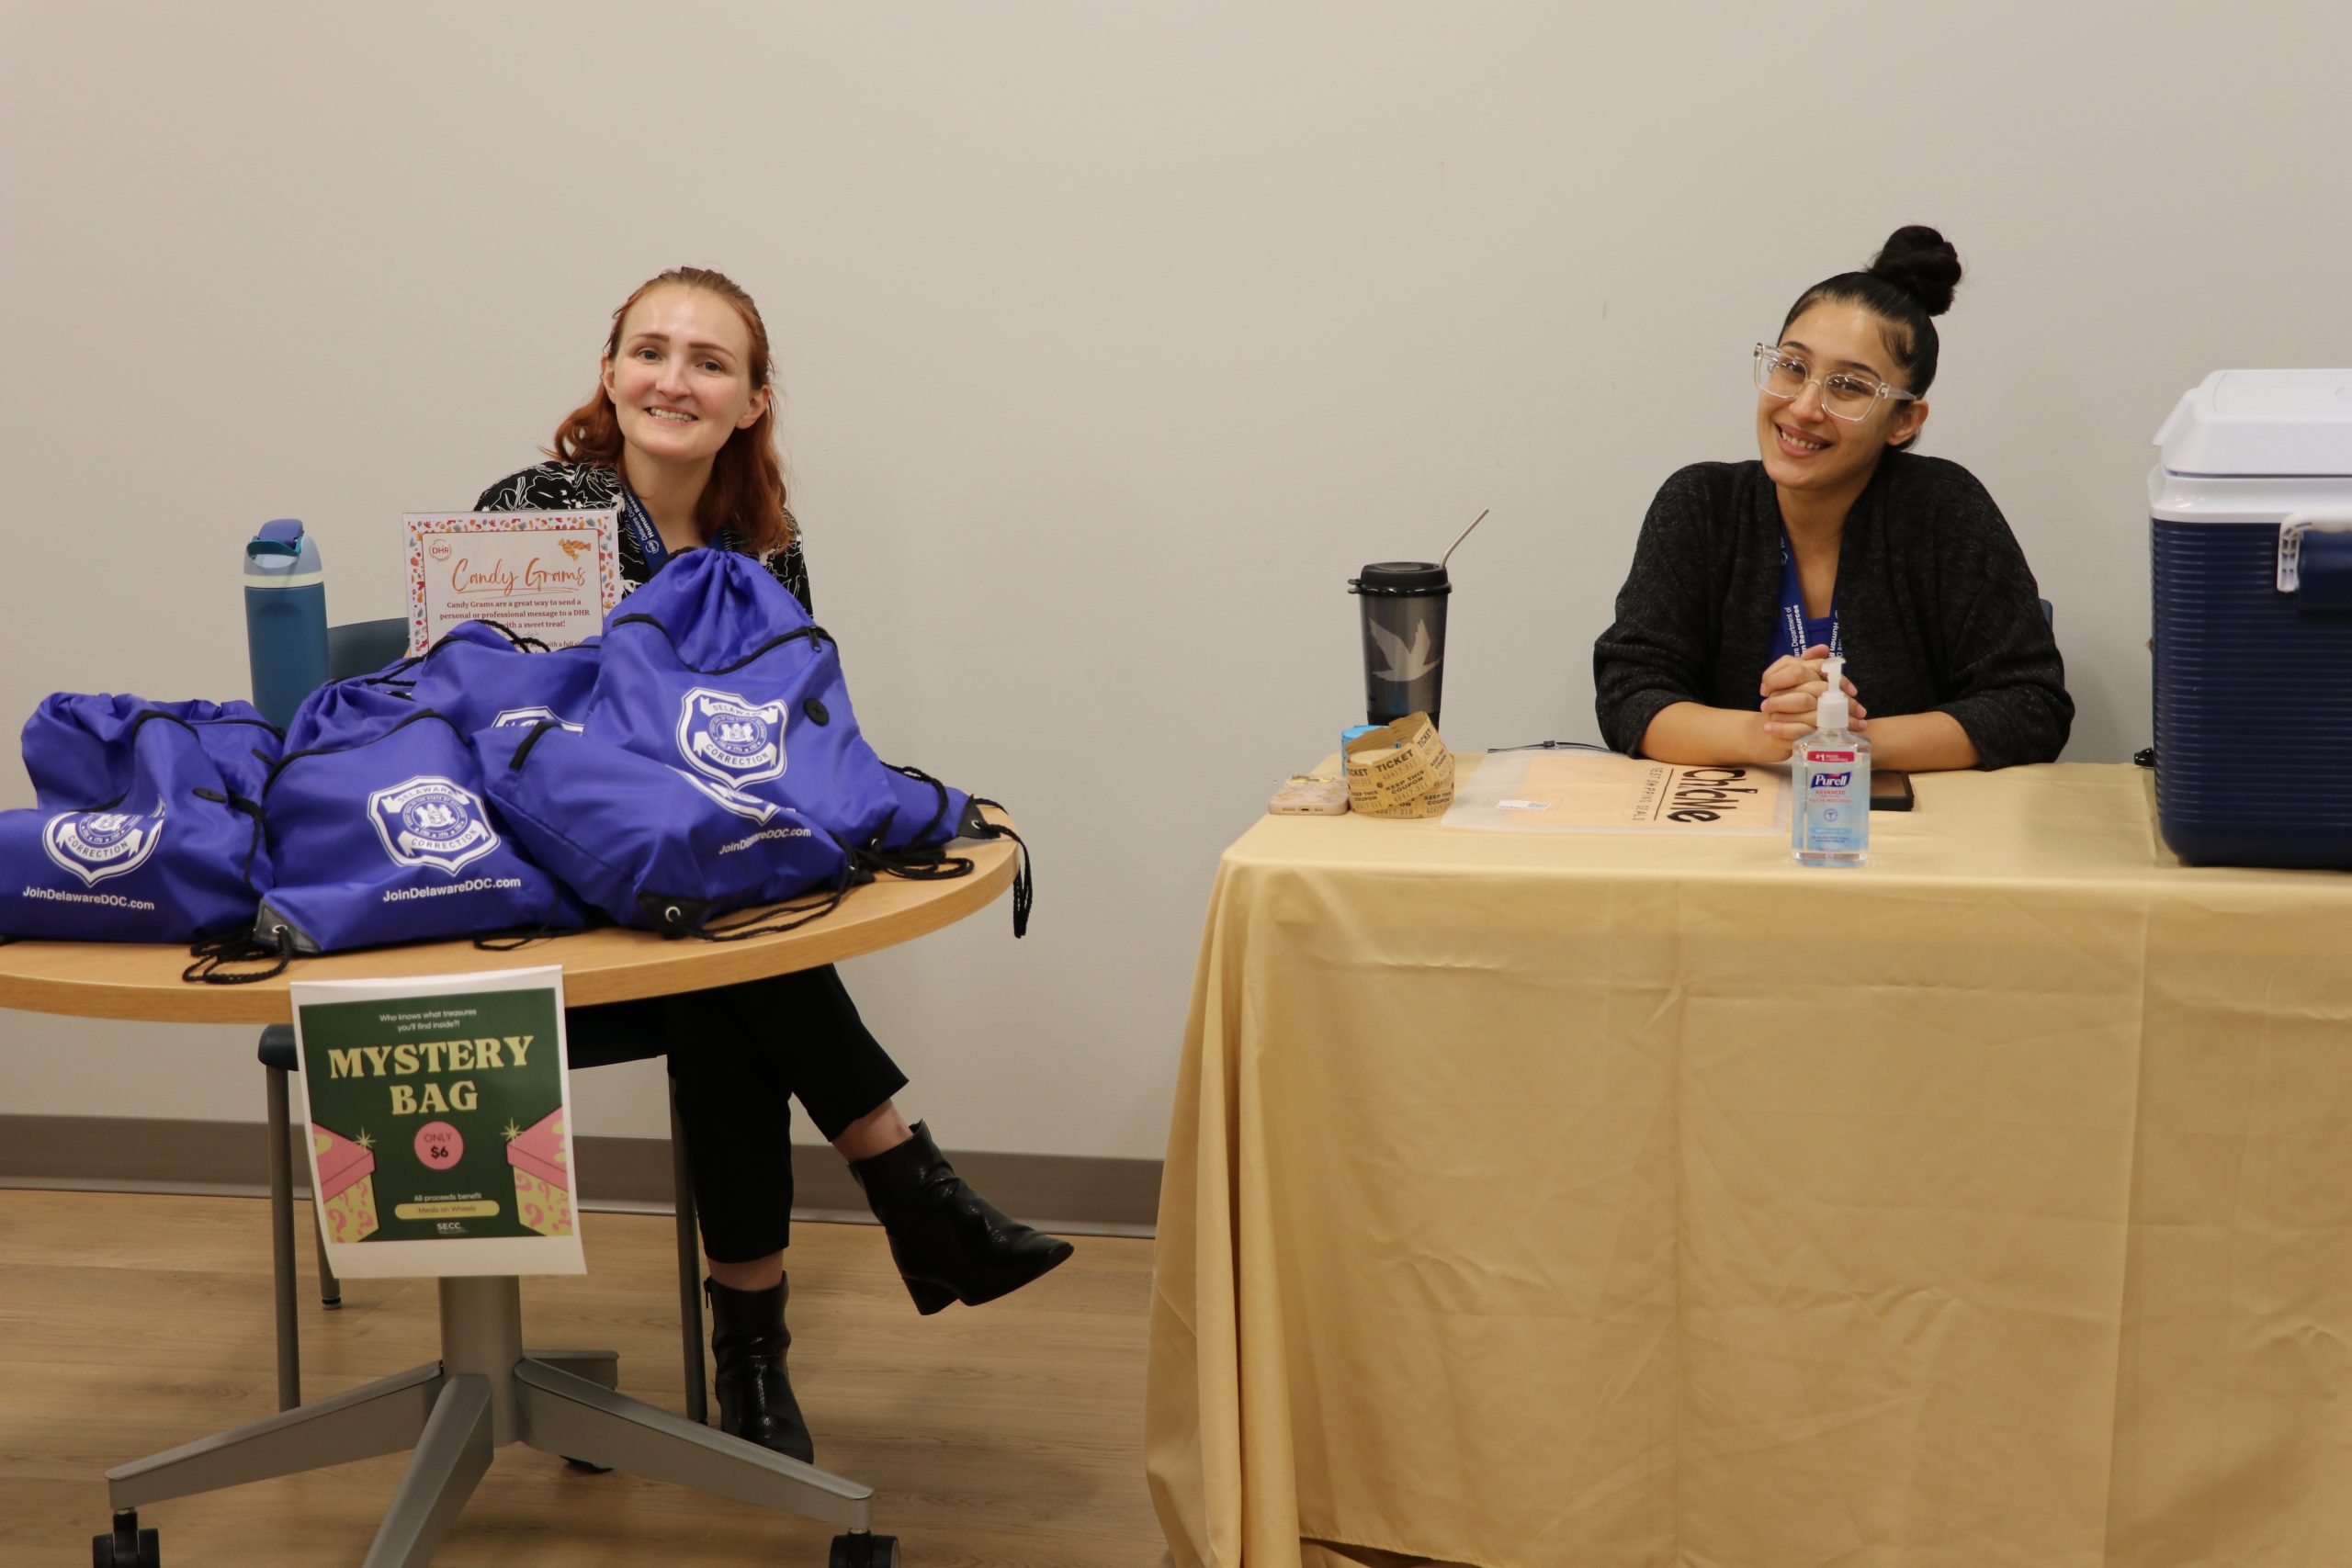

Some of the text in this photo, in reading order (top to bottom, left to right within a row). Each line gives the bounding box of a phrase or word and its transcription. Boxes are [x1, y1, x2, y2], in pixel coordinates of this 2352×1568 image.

[632, 516, 649, 541] Delaware
[638, 512, 654, 538] Human
[452, 557, 586, 596] Candy Grams
[439, 612, 471, 620] personal
[481, 610, 526, 620] professional
[447, 601, 469, 609] Candy
[514, 600, 532, 609] great
[1786, 613, 1799, 648] Department
[1793, 604, 1806, 645] Resources
[1829, 622, 1839, 651] Human
[1418, 728, 1432, 748] TICKET
[706, 743, 769, 766] CORRECTION
[1375, 749, 1413, 773] TICKET
[1385, 770, 1424, 791] KEEP THIS
[1391, 776, 1423, 795] COUPON
[1815, 774, 1848, 786] Purell
[67, 834, 129, 858] CORRECTION
[411, 828, 478, 850] CORRECTION
[22, 886, 155, 910] JoinDelawareDOC.com
[383, 878, 522, 902] JoinDelawareDOC.com
[379, 1013, 398, 1022] Who
[423, 1010, 442, 1019] what
[443, 1009, 478, 1018] treasures
[397, 1021, 417, 1033] you'll
[417, 1021, 432, 1030] find
[328, 1034, 535, 1079] MYSTERY
[390, 1080, 479, 1115] BAG
[424, 1133, 452, 1143] ONLY
[430, 1145, 449, 1159] $6
[413, 1191, 481, 1202] All proceeds benefit
[436, 1222, 460, 1230] SECC
